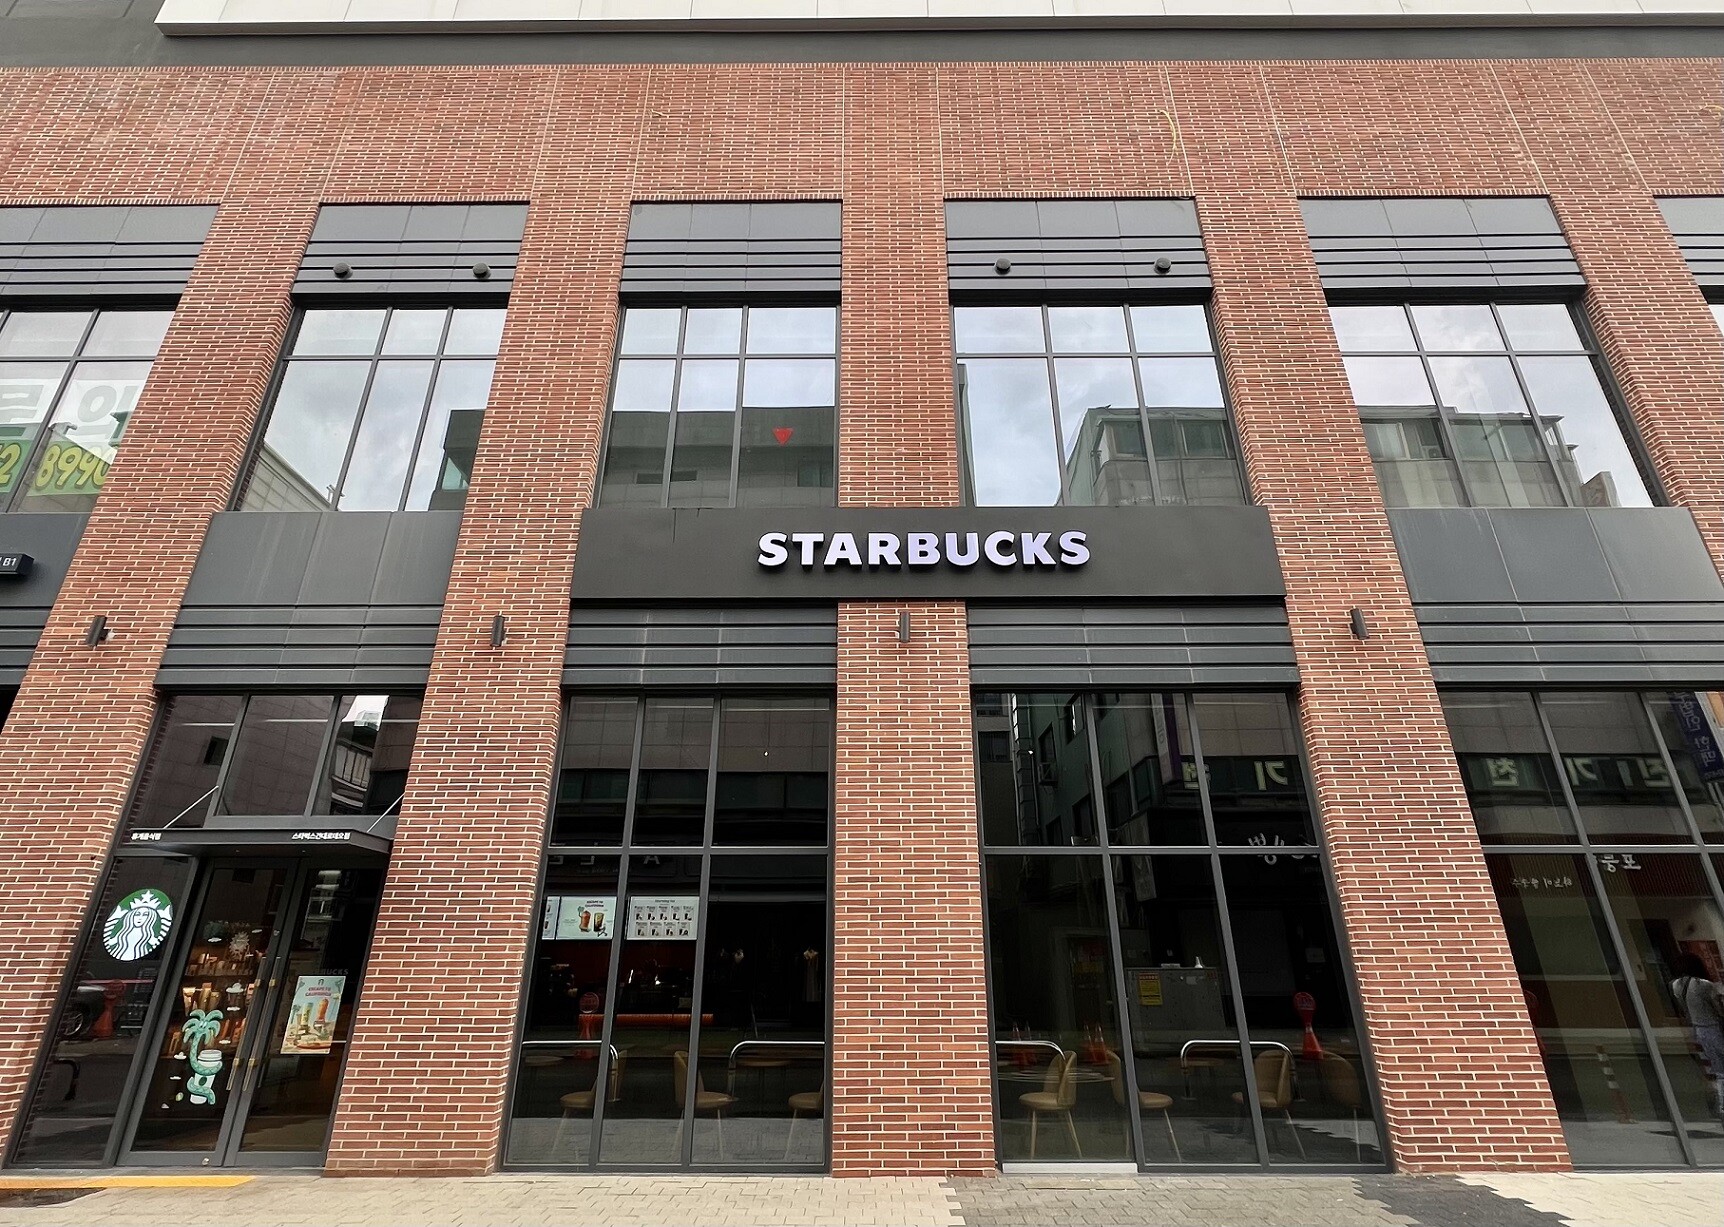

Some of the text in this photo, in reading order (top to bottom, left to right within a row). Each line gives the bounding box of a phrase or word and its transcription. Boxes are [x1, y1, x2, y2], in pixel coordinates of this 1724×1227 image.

[0, 443, 21, 485] 2
[2, 557, 17, 567] B1
[757, 530, 1091, 568] STARBUCKS
